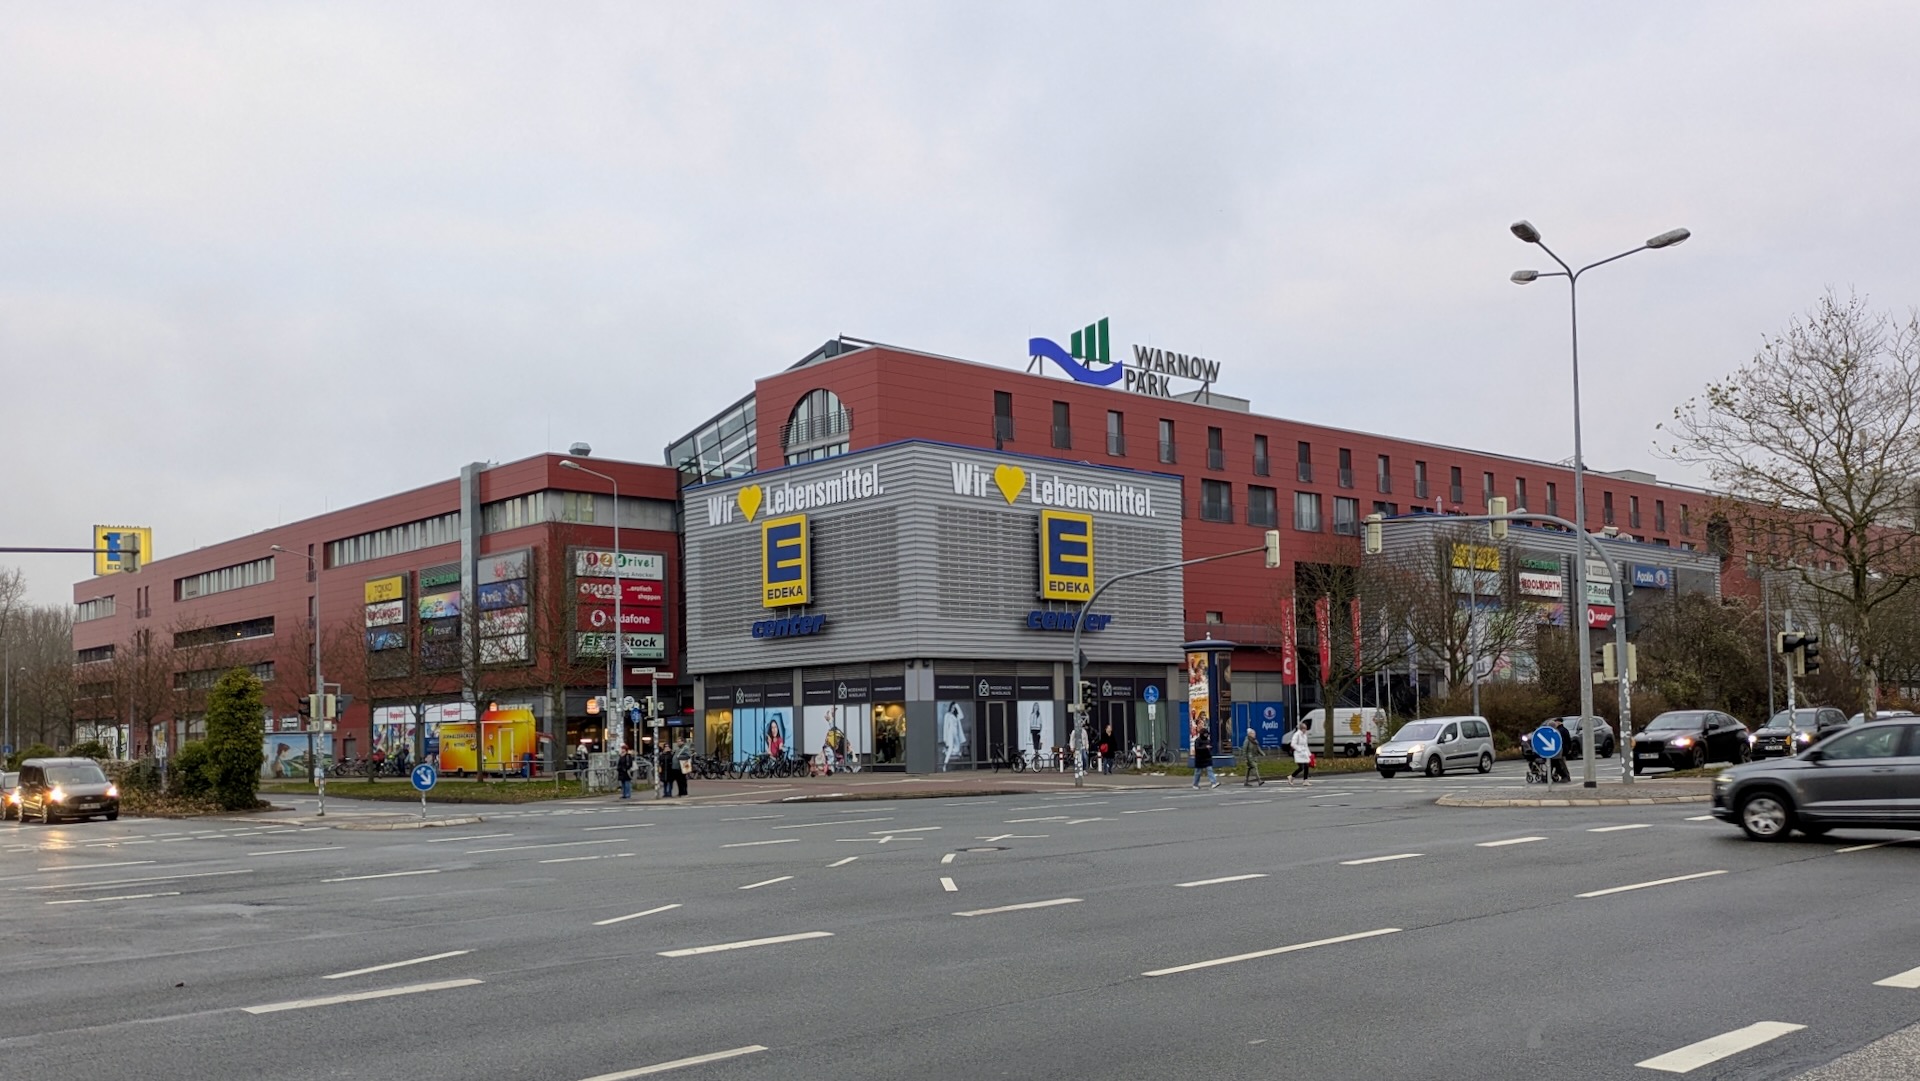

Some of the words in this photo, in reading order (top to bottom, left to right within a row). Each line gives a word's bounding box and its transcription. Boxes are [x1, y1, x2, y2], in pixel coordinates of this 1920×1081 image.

[1132, 344, 1221, 383] WARNOW
[1124, 368, 1171, 398] PARK
[708, 495, 735, 527] Wir
[766, 464, 884, 516] Lebensmittel.
[952, 462, 990, 497] Wir
[1030, 473, 1156, 517] Lebensmittel.
[767, 522, 802, 584] E
[1048, 517, 1089, 578] E
[1049, 581, 1090, 594] EDEKA
[1521, 578, 1560, 591] WOOLWORTH
[1637, 570, 1654, 583] Apollo
[767, 585, 804, 600] EDEKA
[607, 613, 651, 625] vdafone
[752, 613, 827, 639] center
[1262, 721, 1279, 731] Apollo
